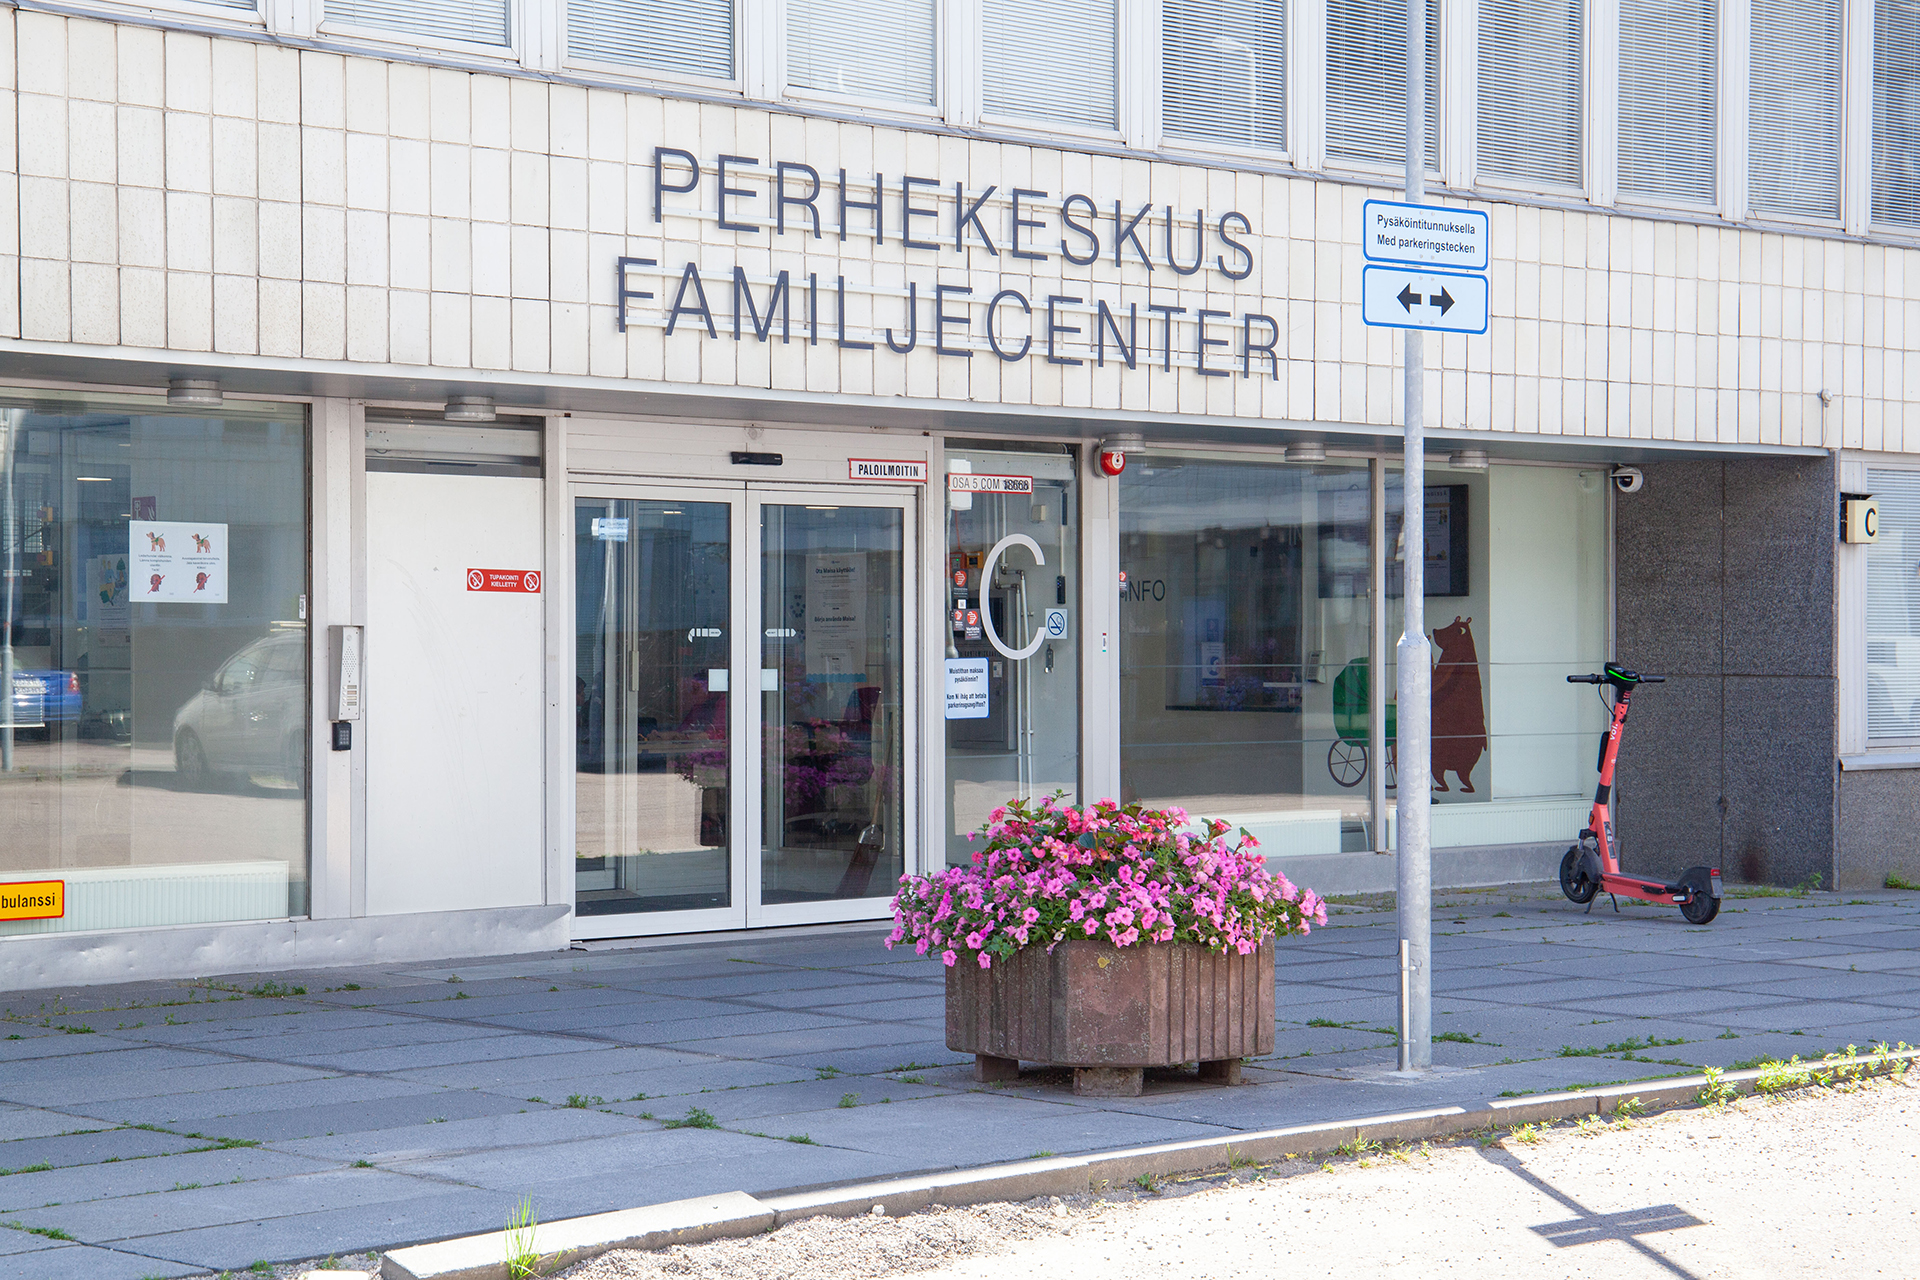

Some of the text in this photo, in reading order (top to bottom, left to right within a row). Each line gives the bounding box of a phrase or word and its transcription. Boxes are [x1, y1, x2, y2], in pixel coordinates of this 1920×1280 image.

[654, 146, 1254, 280] PERHEKESKUS
[1377, 214, 1476, 234] Pysäköintitunnuksella
[1377, 234, 1476, 253] Med parkeringstecken
[618, 256, 1279, 381] FAMILJECENTER
[858, 464, 919, 477] PALOILMOITIN
[952, 477, 970, 488] OSA
[972, 478, 978, 489] 5
[981, 478, 1000, 490] COM
[1864, 508, 1877, 537] C
[979, 533, 1046, 660] C
[975, 692, 987, 700] betala
[1, 892, 56, 909] bulanssi
